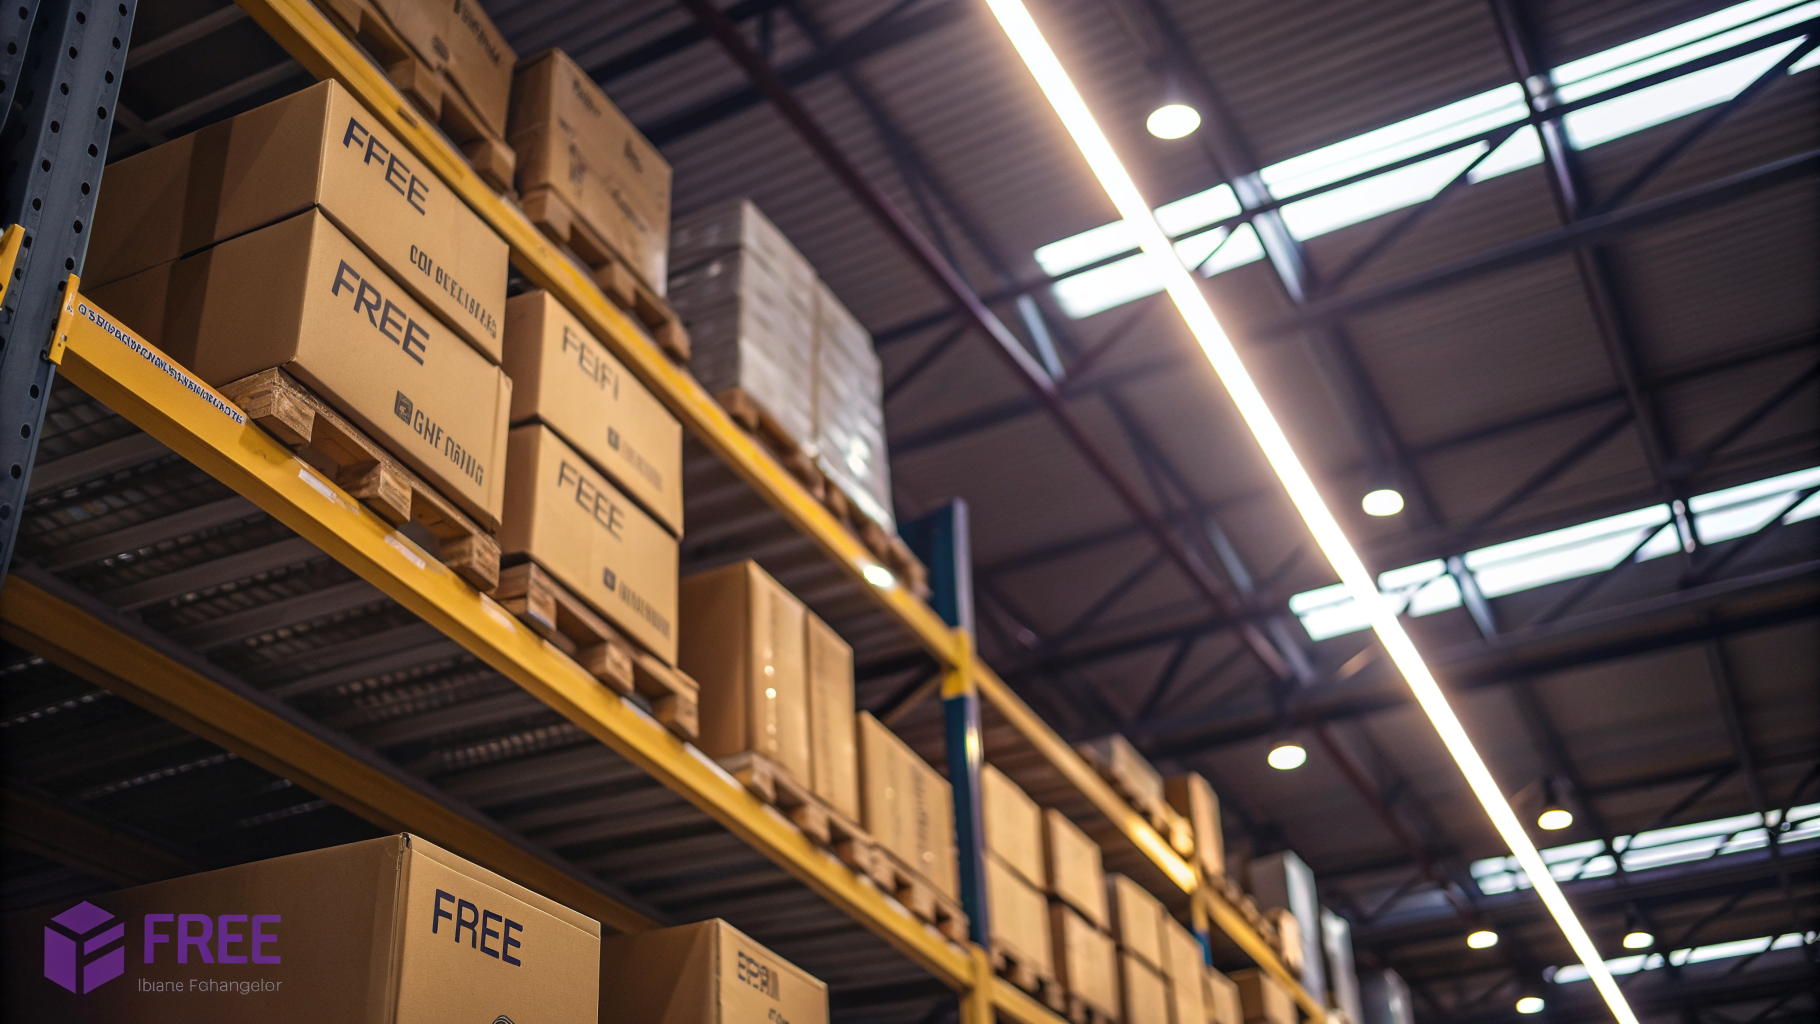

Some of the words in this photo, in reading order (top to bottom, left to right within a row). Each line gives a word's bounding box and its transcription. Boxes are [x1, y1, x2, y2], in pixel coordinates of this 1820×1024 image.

[343, 117, 429, 216] FFEE
[331, 259, 430, 366] FREE
[432, 889, 523, 967] FREE
